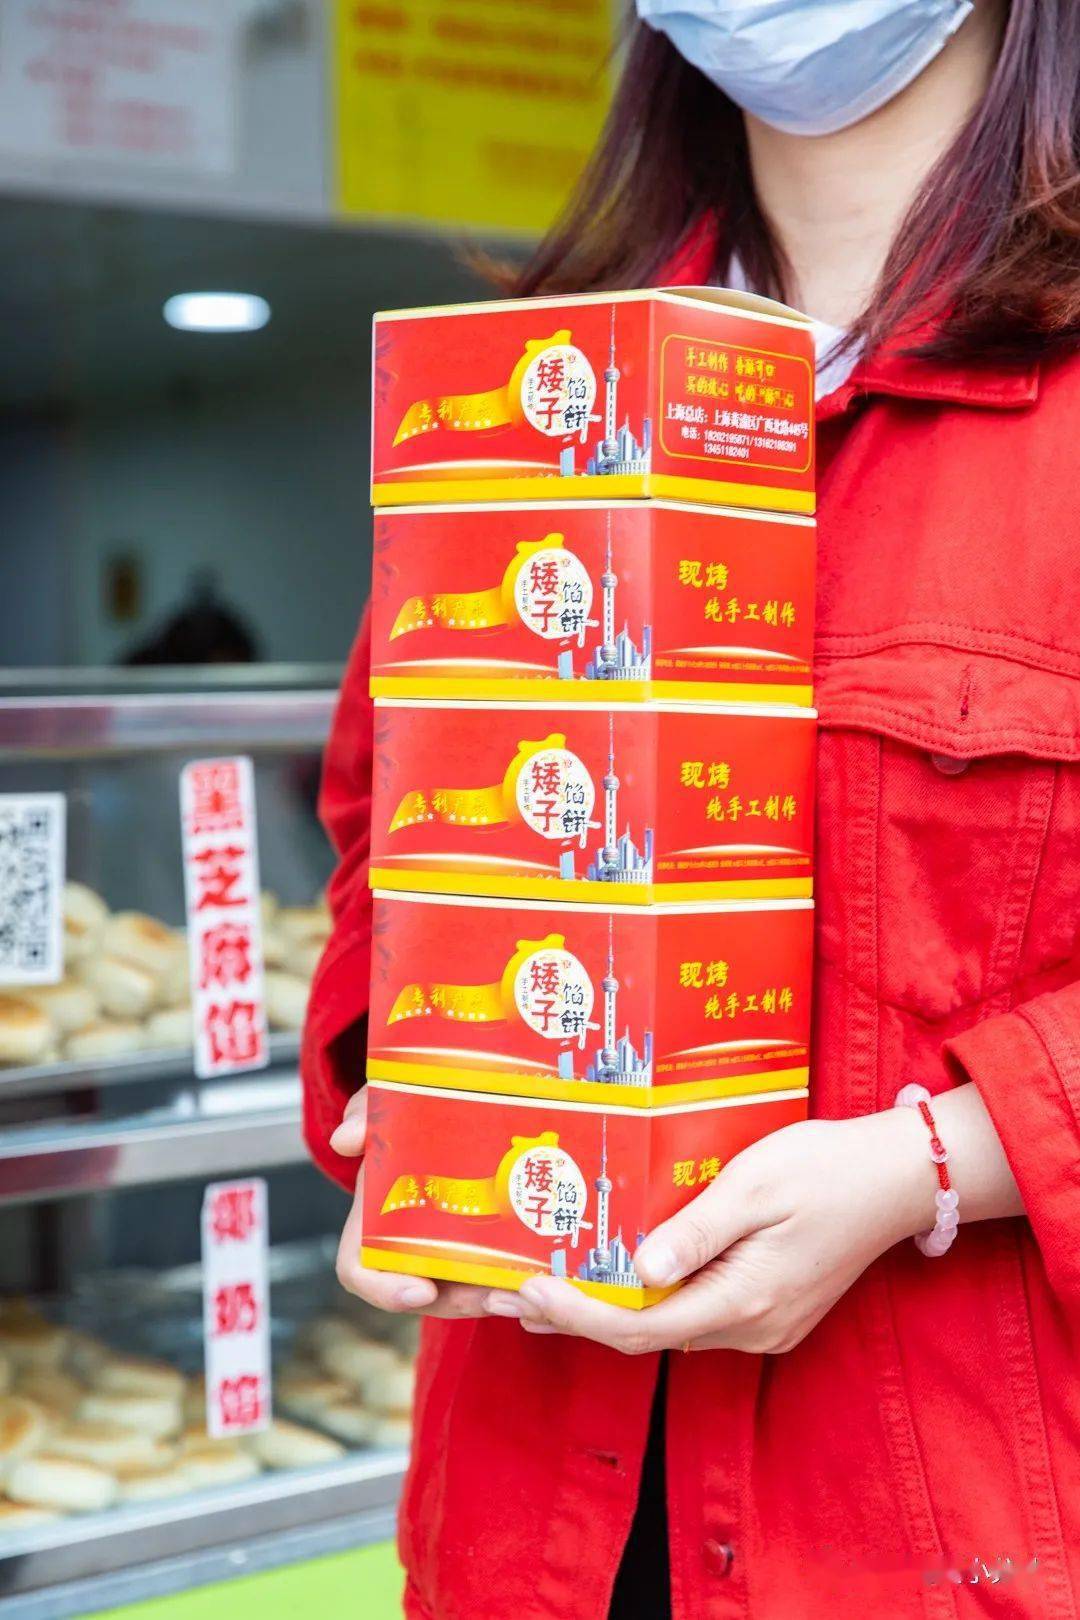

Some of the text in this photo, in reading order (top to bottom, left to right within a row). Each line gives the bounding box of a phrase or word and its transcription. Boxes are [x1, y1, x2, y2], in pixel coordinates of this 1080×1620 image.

[536, 358, 564, 430] 矮子
[678, 559, 730, 591] 现烤
[530, 561, 559, 633] 矮子
[704, 596, 797, 628] 纯手工制作
[680, 760, 731, 789] 现烤
[532, 761, 561, 833] 矮子
[705, 795, 797, 822] 纯手工制作
[679, 960, 730, 989] 现烤
[530, 960, 559, 1032] 矮子
[704, 987, 794, 1020] 纯手工制作
[672, 1156, 721, 1188] 现烤
[524, 1157, 554, 1229] 矮子
